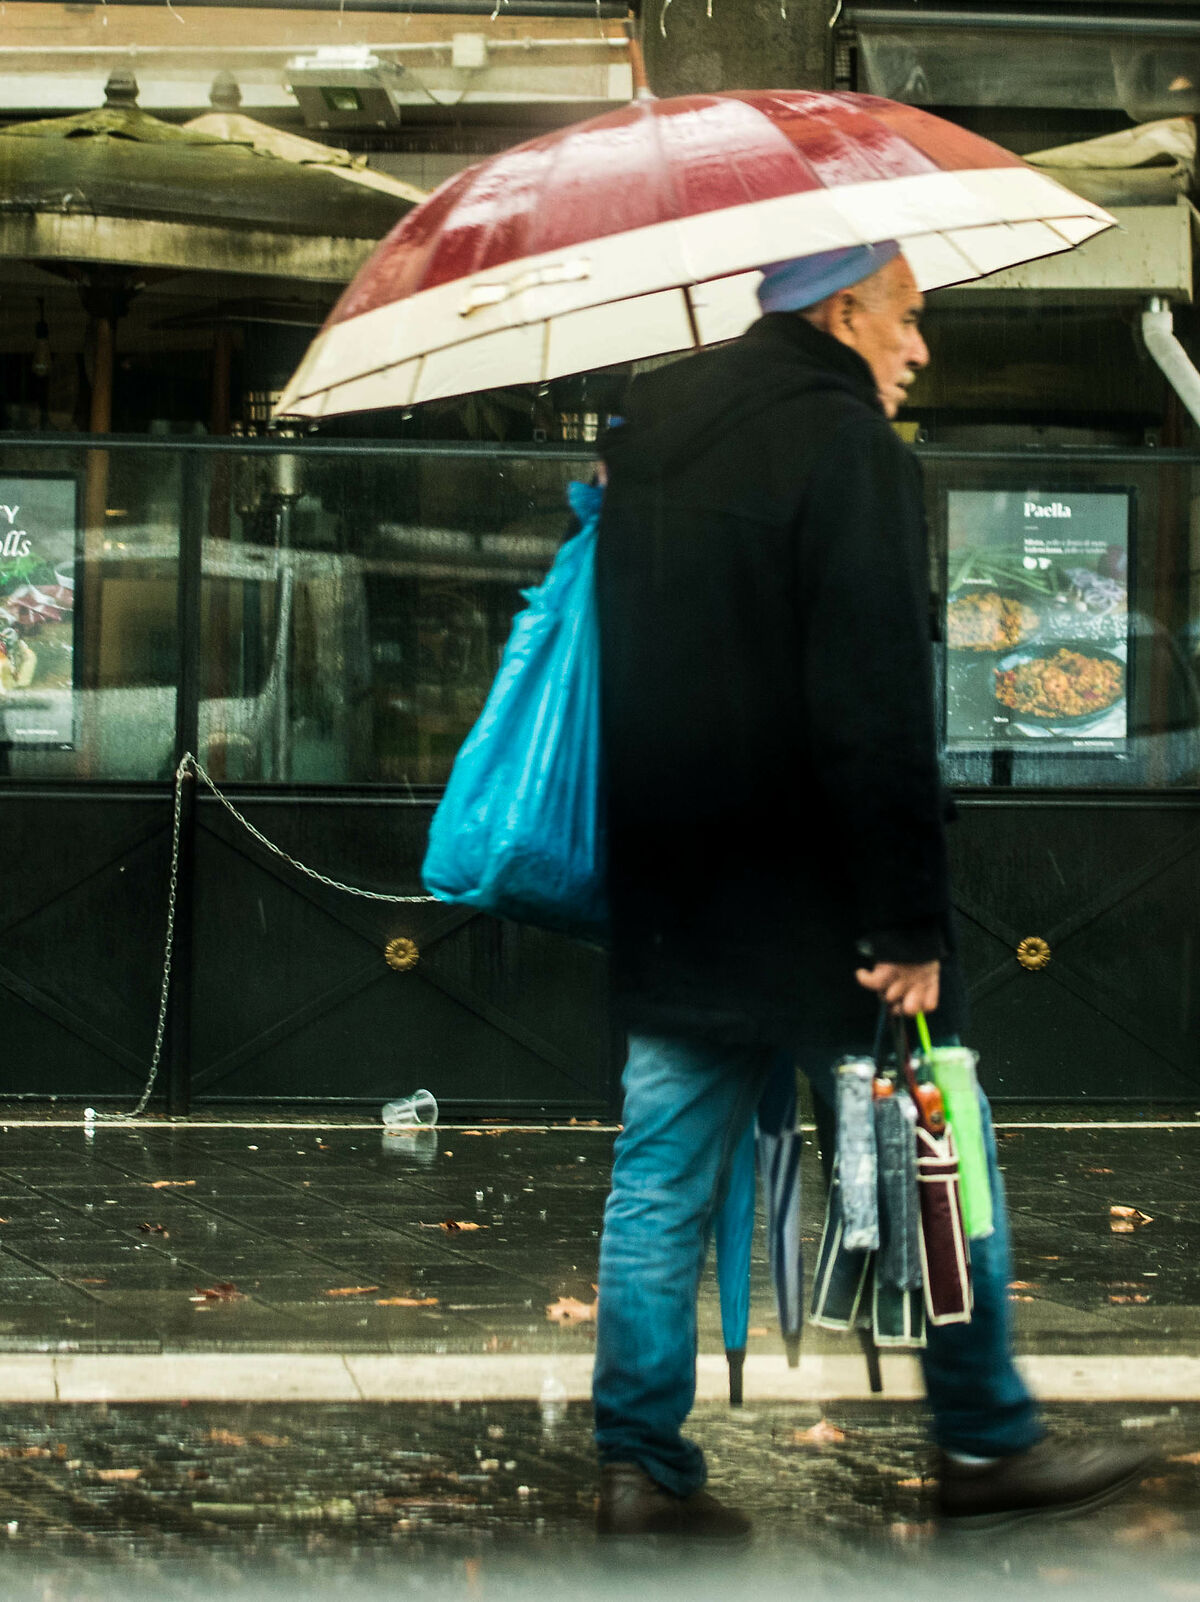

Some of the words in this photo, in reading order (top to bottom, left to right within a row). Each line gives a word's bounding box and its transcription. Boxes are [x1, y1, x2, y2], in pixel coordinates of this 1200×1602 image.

[0, 505, 20, 524] Y
[1024, 502, 1072, 518] Paella
[0, 530, 32, 557] lls
